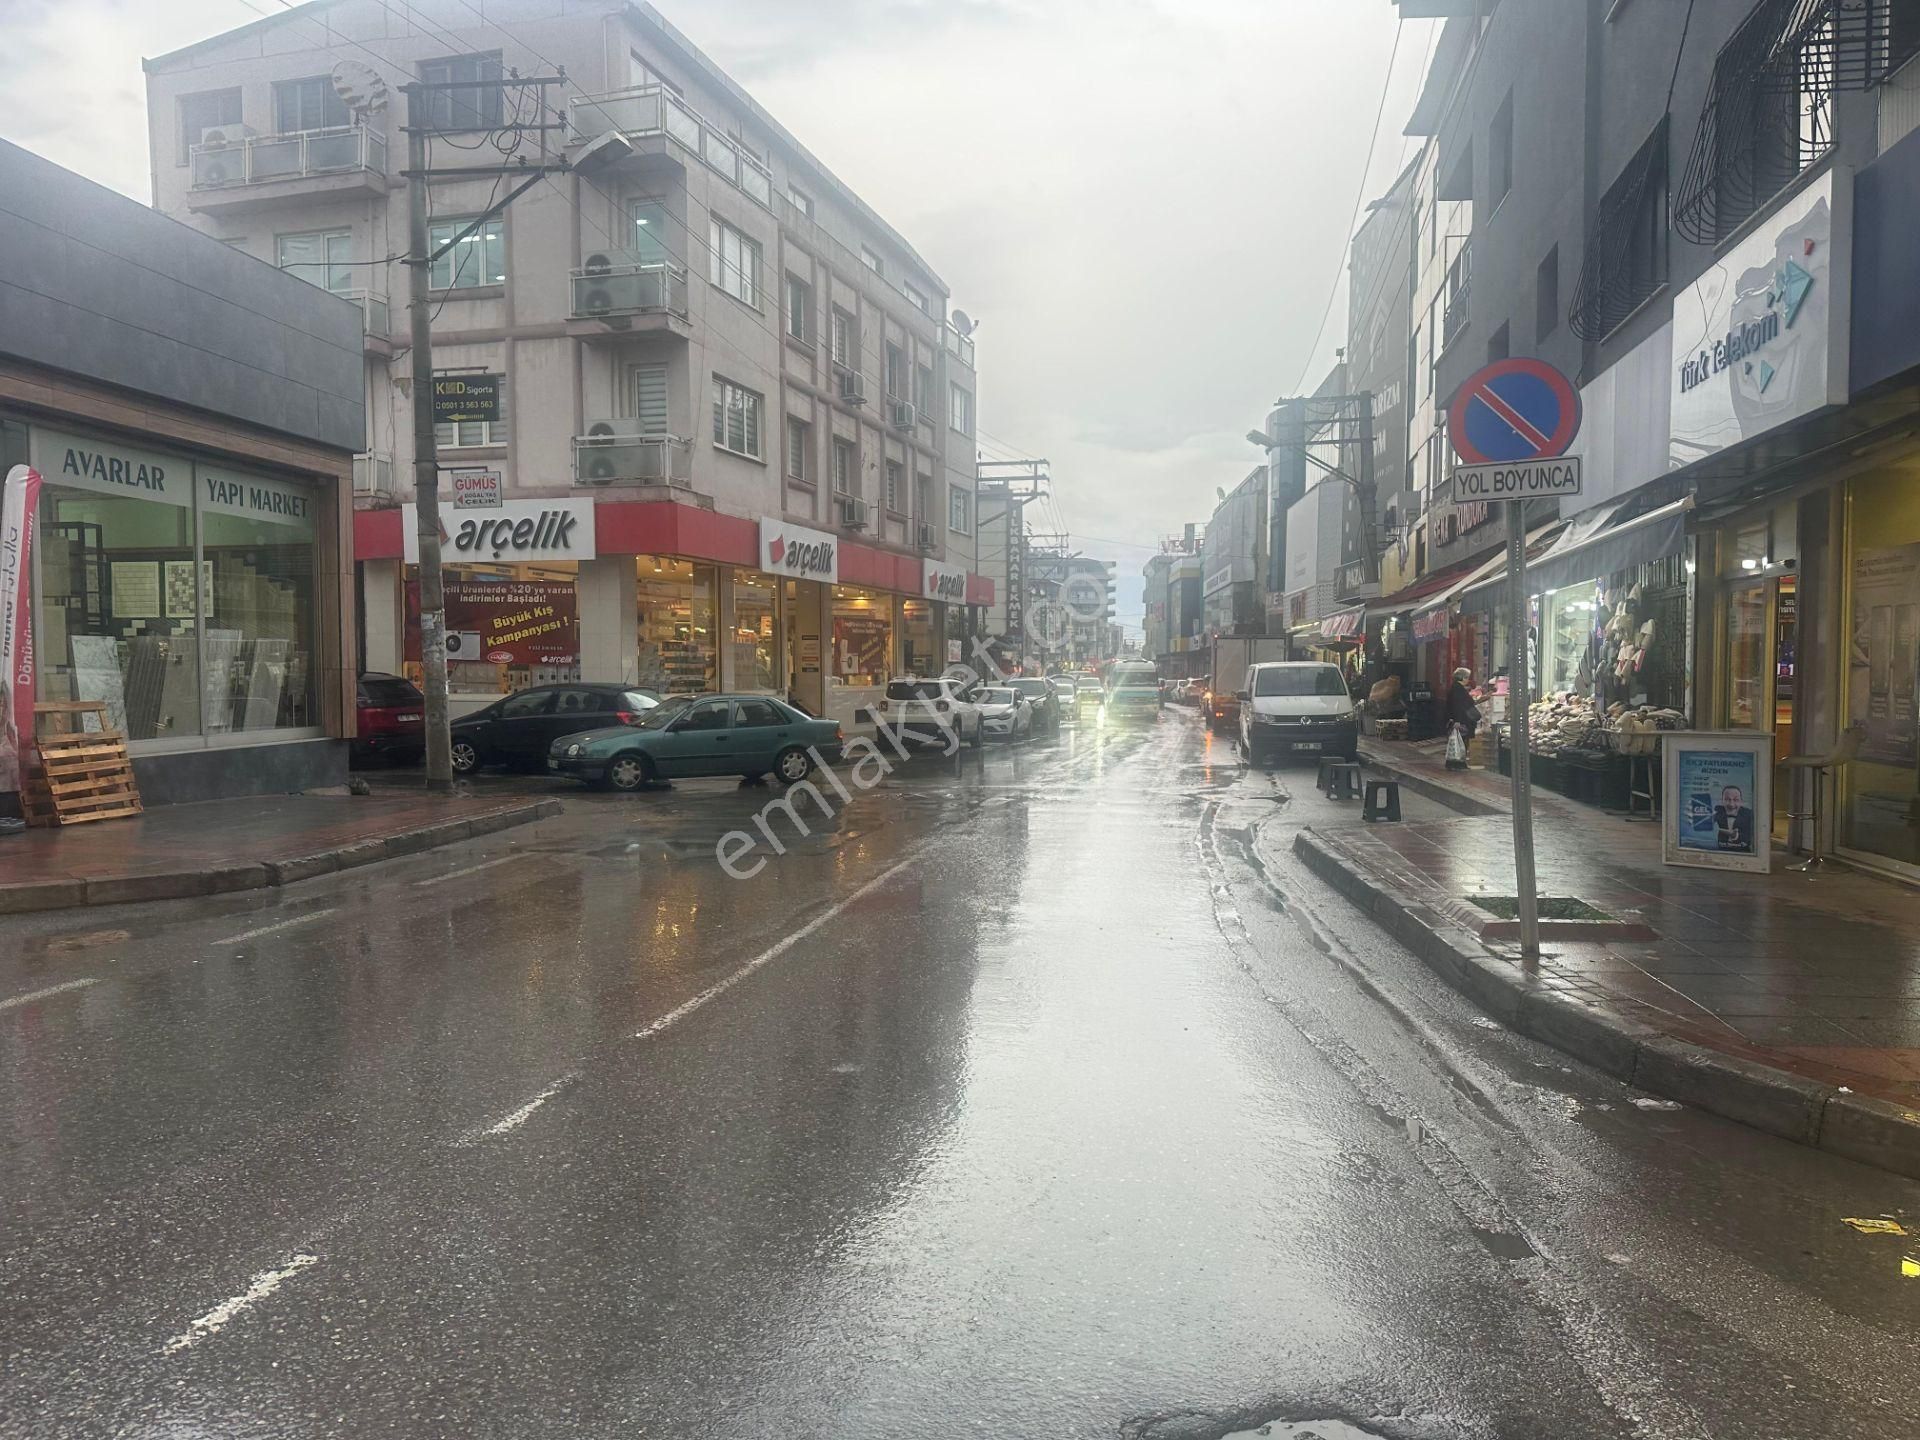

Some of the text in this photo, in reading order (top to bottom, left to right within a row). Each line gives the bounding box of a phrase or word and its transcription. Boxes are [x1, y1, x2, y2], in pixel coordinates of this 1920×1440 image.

[466, 386, 493, 396] Sigorta
[63, 448, 165, 492] AVARLAR
[1458, 465, 1576, 495] YOL BOYUNCA
[207, 478, 308, 518] YAPI MARKET
[454, 510, 578, 559] arçelik
[785, 539, 835, 577] arçelik
[547, 586, 574, 595] varan
[937, 572, 966, 600] arçelik
[493, 604, 554, 630] Büyük Kış
[1009, 586, 1020, 628] EKMEK
[486, 620, 562, 648] Kampanyası
[548, 655, 574, 665] arçelik
